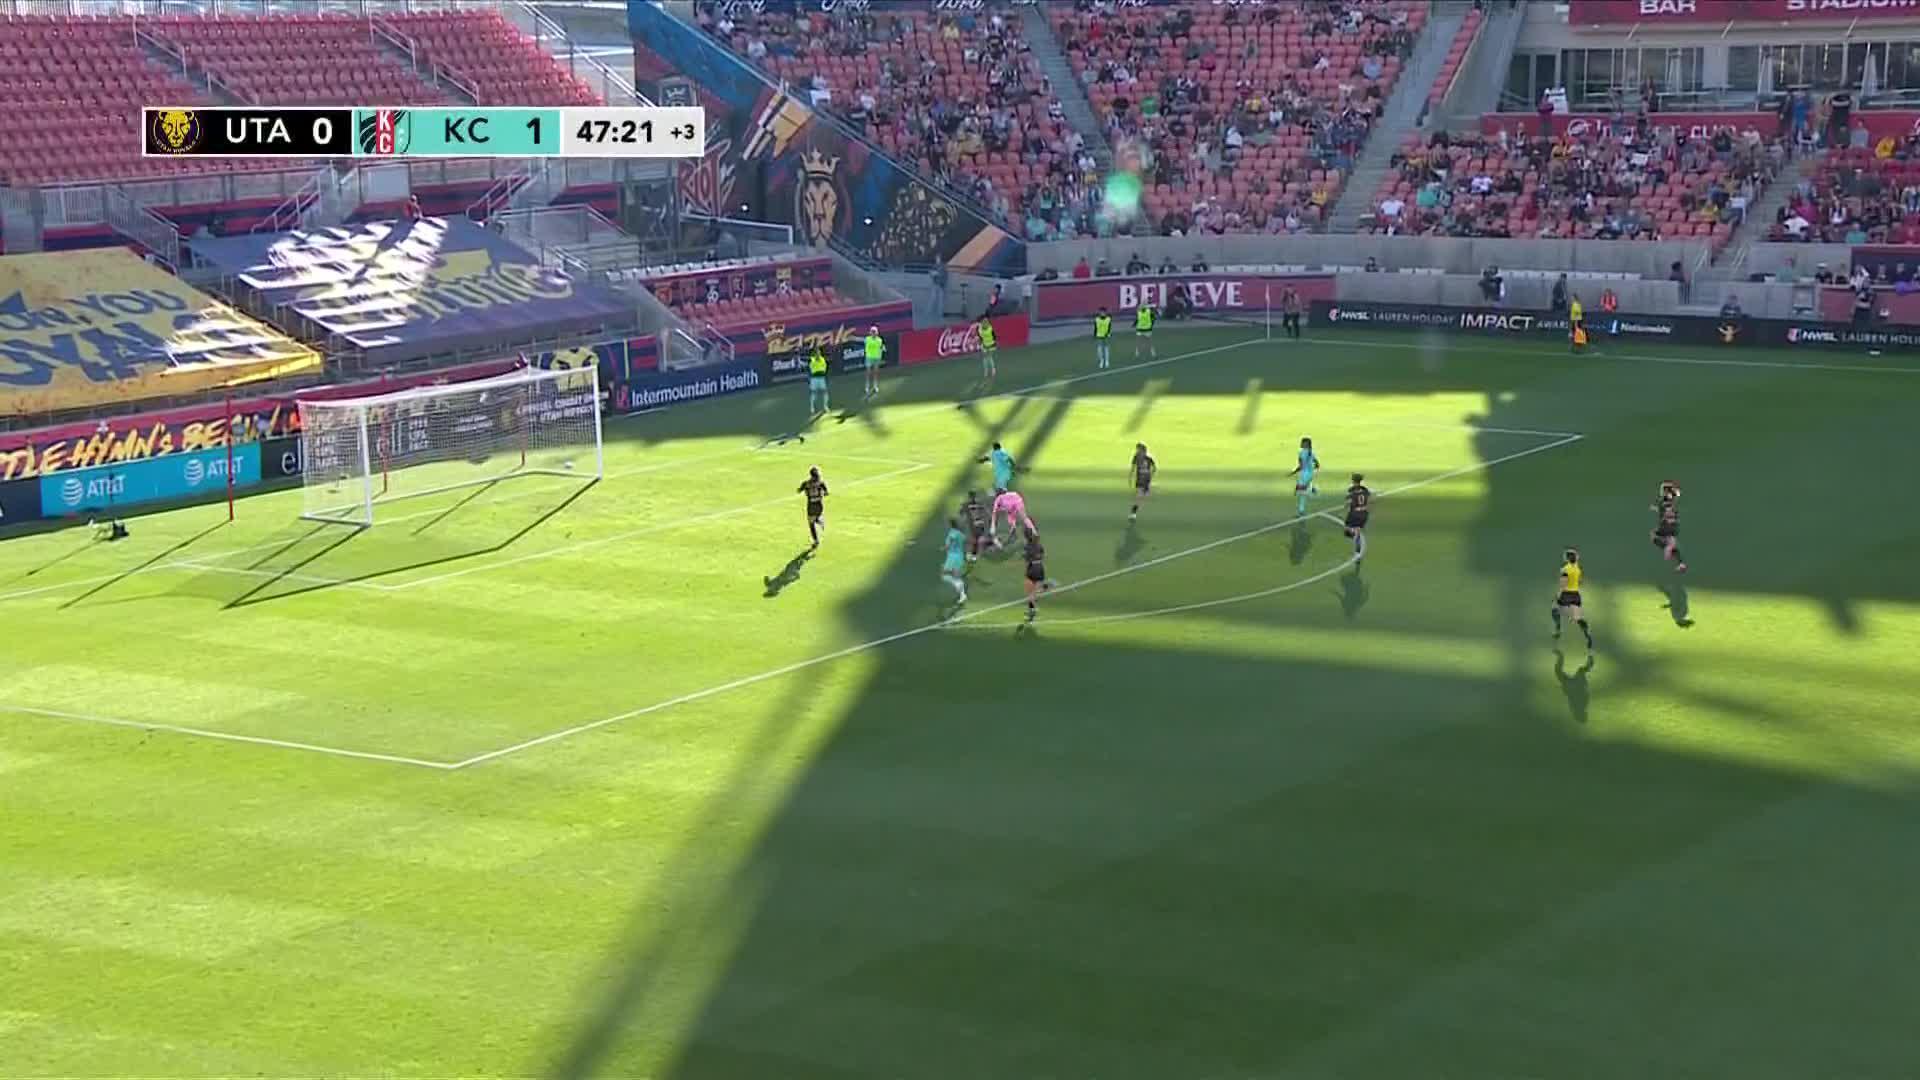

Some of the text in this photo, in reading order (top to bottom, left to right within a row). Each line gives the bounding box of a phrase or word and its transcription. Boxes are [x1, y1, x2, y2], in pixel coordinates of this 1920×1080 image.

[1640, 0, 1696, 15] BAR
[1119, 281, 1244, 309] BELEVE
[1460, 313, 1534, 330] IMPACT
[631, 370, 759, 407] Intermountain Health
